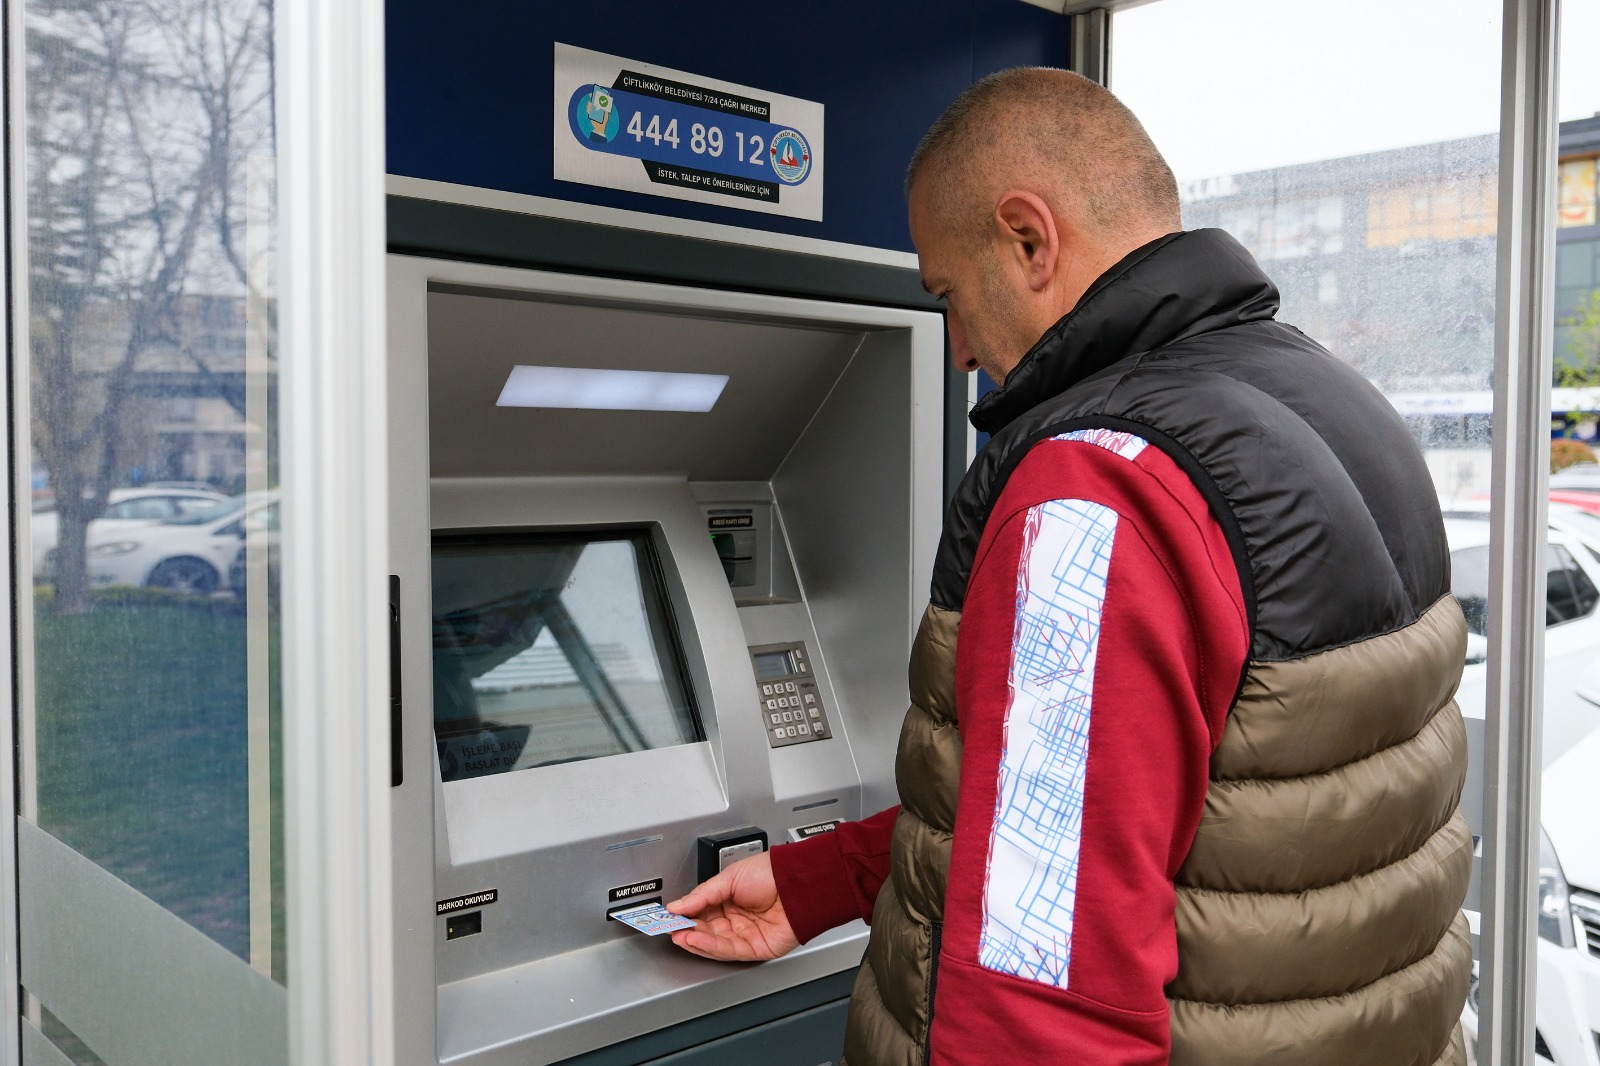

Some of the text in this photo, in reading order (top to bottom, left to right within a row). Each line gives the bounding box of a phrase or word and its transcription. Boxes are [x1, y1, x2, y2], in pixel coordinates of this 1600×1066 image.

[623, 76, 768, 115] ÇİFTLİKKÖY BELEDİYESİ 7/24 ÇAĞRI MERKEZİ
[627, 111, 764, 166] 444 89 12
[658, 167, 770, 196] İSTEK, TALEP VE ÖNERİLERİNİZ İÇİN
[465, 757, 501, 773] BAŞLAT
[616, 882, 656, 898] KART OKUYUCU
[437, 893, 494, 911] BARKOD OKUYUCU
